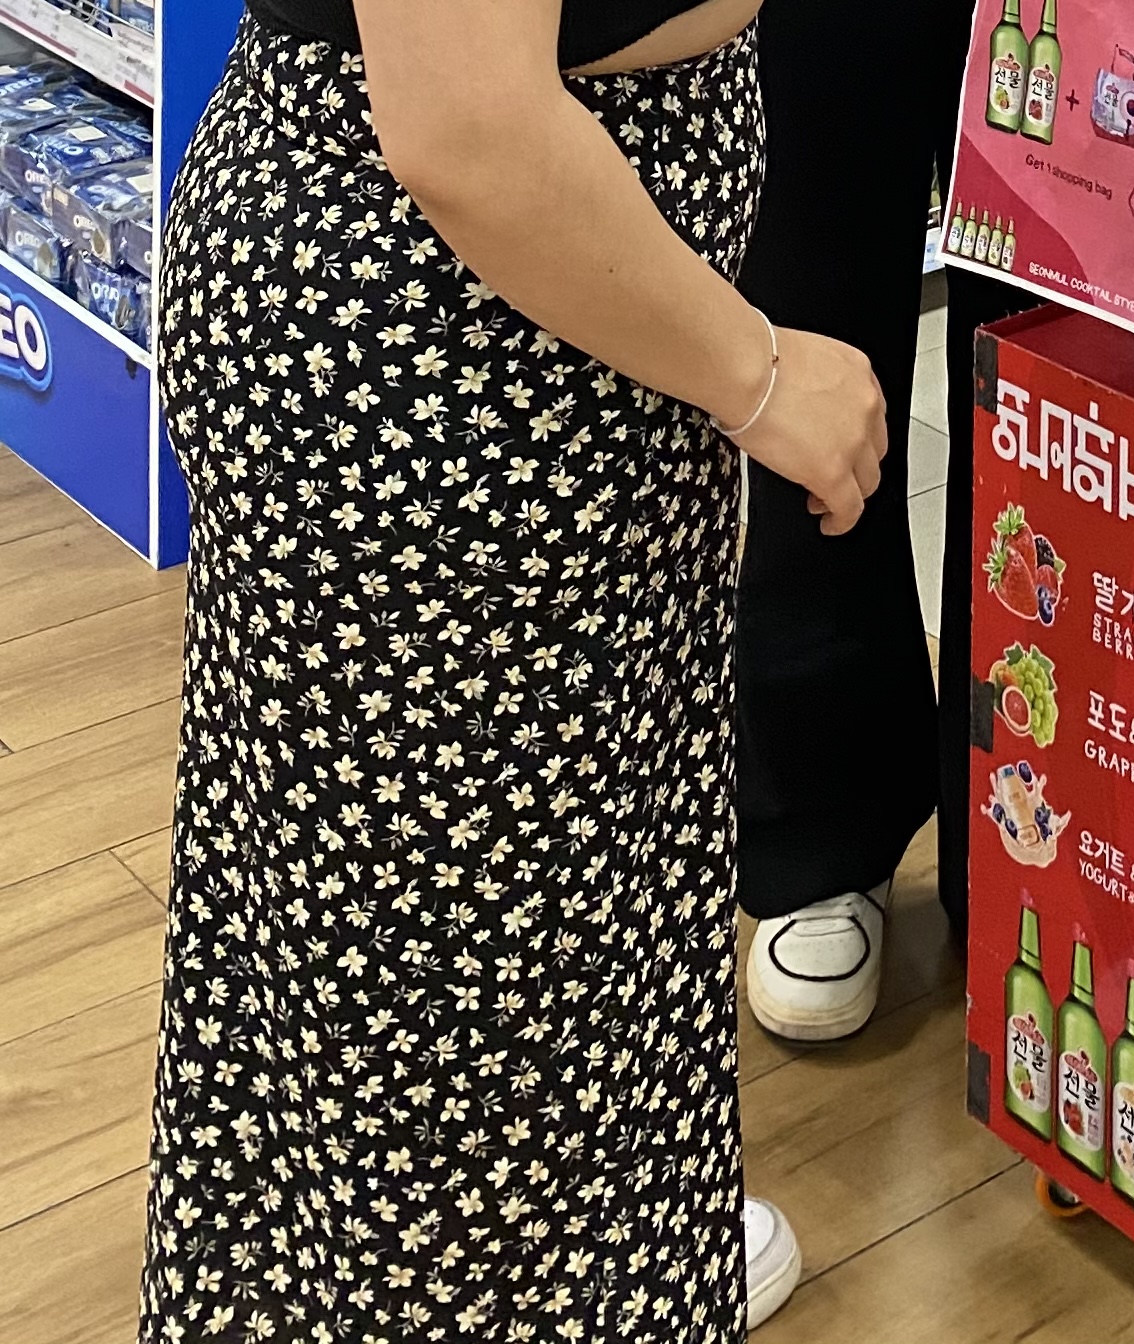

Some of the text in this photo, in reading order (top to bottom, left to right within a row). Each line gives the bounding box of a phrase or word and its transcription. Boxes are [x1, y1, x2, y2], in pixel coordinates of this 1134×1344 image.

[1025, 153, 1045, 172] Get
[1052, 165, 1093, 193] shopping
[1094, 180, 1113, 201] bag
[1028, 261, 1069, 286] SEONMUL
[1078, 830, 1125, 877] 요거트
